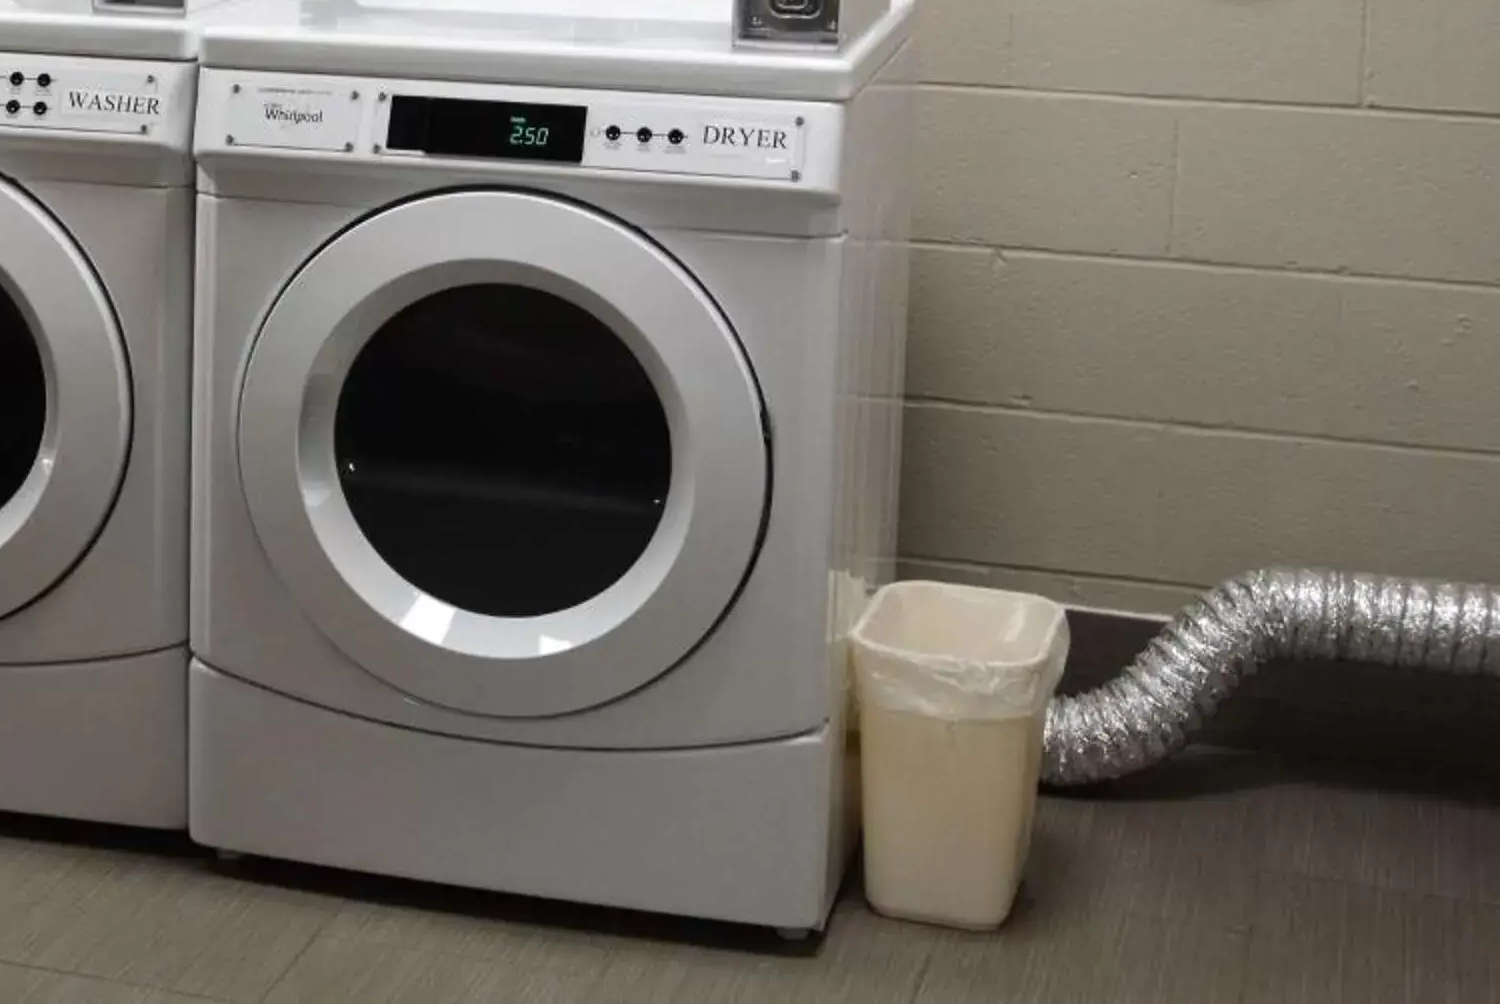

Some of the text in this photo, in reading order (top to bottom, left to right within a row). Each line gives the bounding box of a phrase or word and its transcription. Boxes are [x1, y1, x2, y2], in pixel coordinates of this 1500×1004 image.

[68, 90, 161, 116] WASHER
[263, 105, 323, 125] Whirlpool
[702, 124, 788, 150] DRYER
